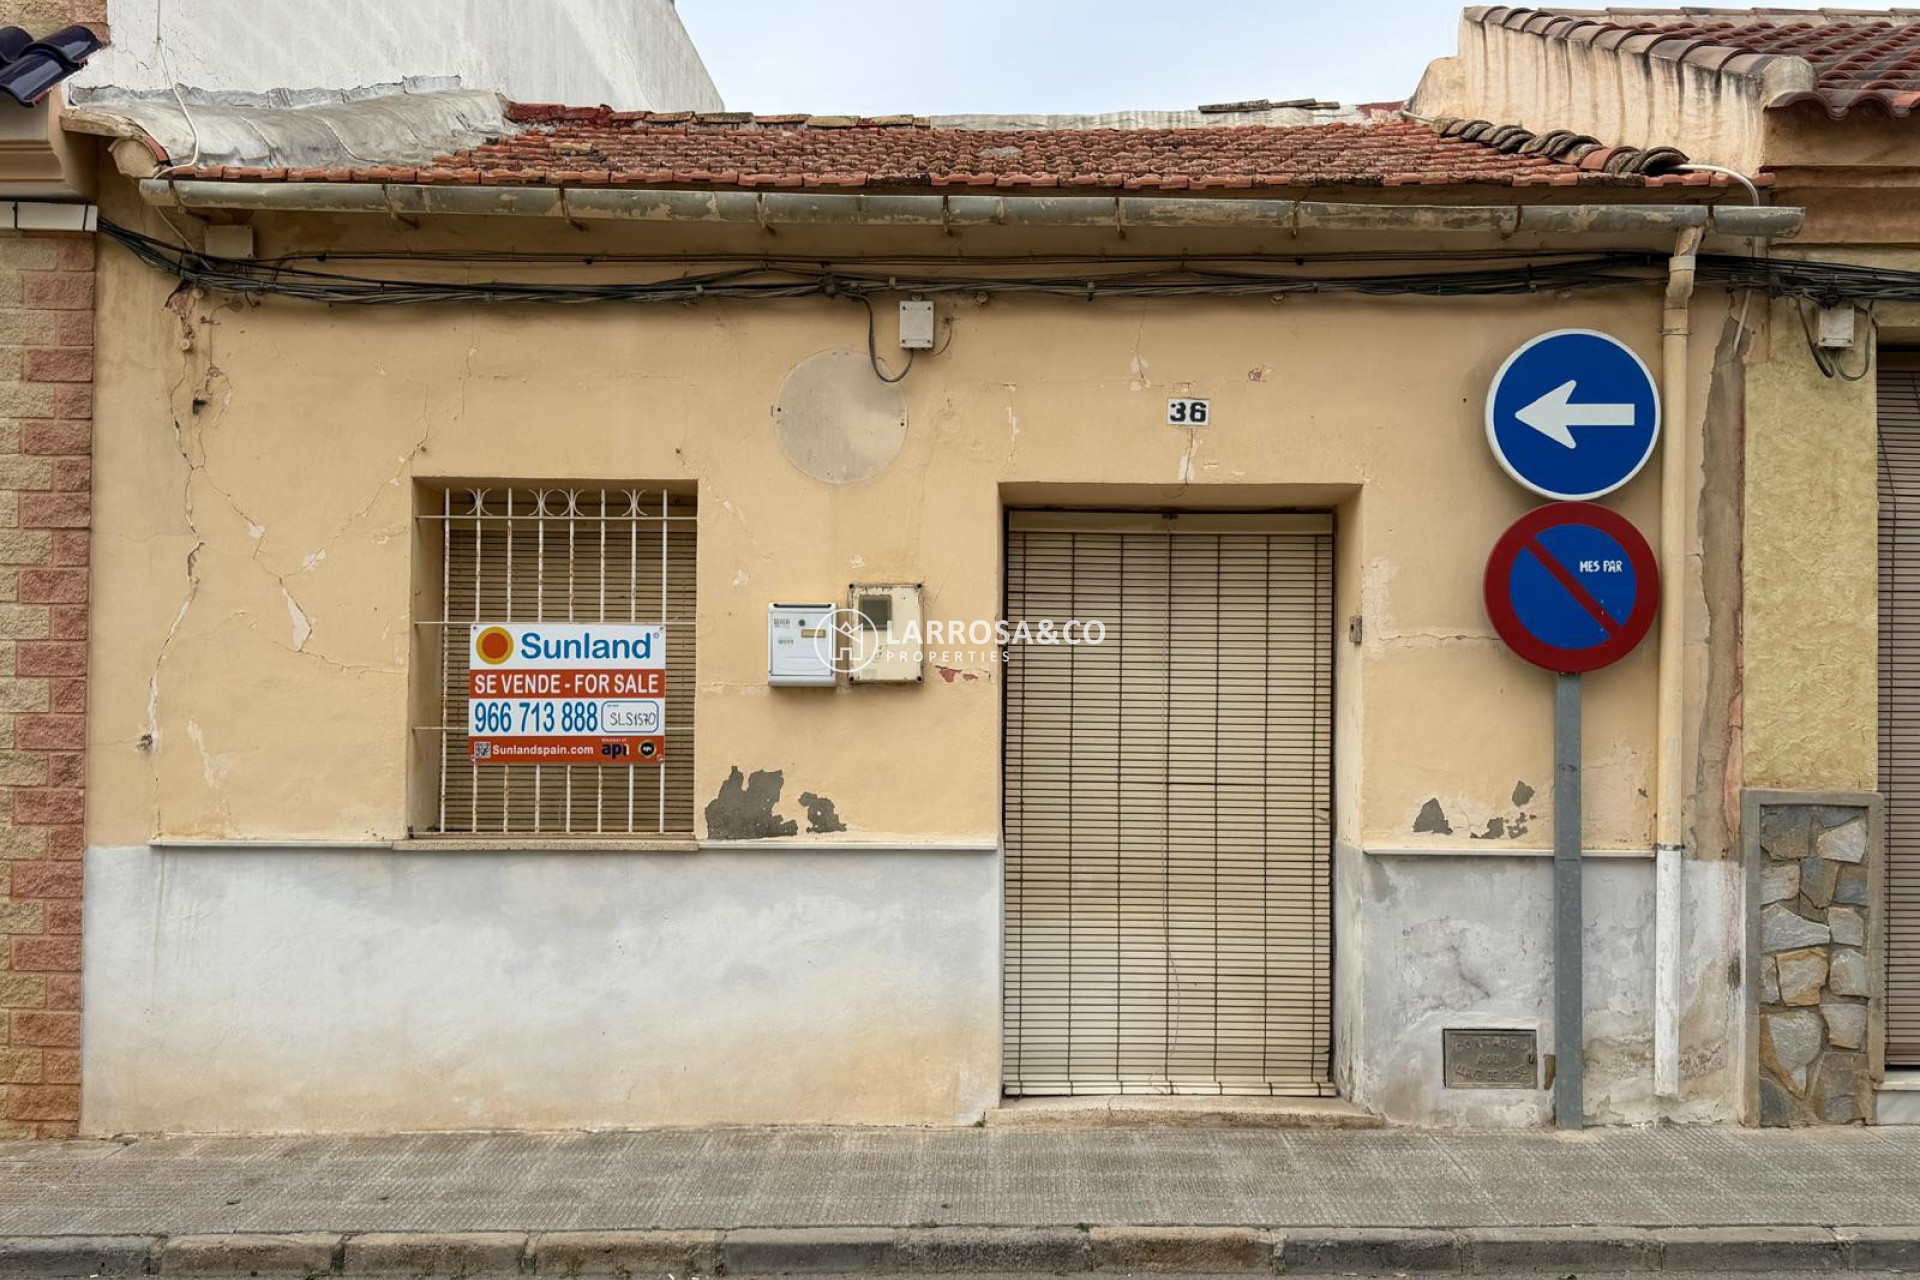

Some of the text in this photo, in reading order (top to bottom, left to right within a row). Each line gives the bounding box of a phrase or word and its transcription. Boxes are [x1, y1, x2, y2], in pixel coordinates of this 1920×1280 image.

[1170, 402, 1206, 422] 36
[1579, 560, 1623, 573] MES PAR
[521, 632, 651, 660] Sunland
[474, 674, 497, 694] SE
[501, 674, 561, 694] VENDE
[575, 674, 609, 694] FOR
[614, 674, 659, 694] SALE
[474, 702, 598, 733] 966 713 888
[610, 711, 657, 726] SLS1570
[492, 744, 594, 758] Sunlandspain.com
